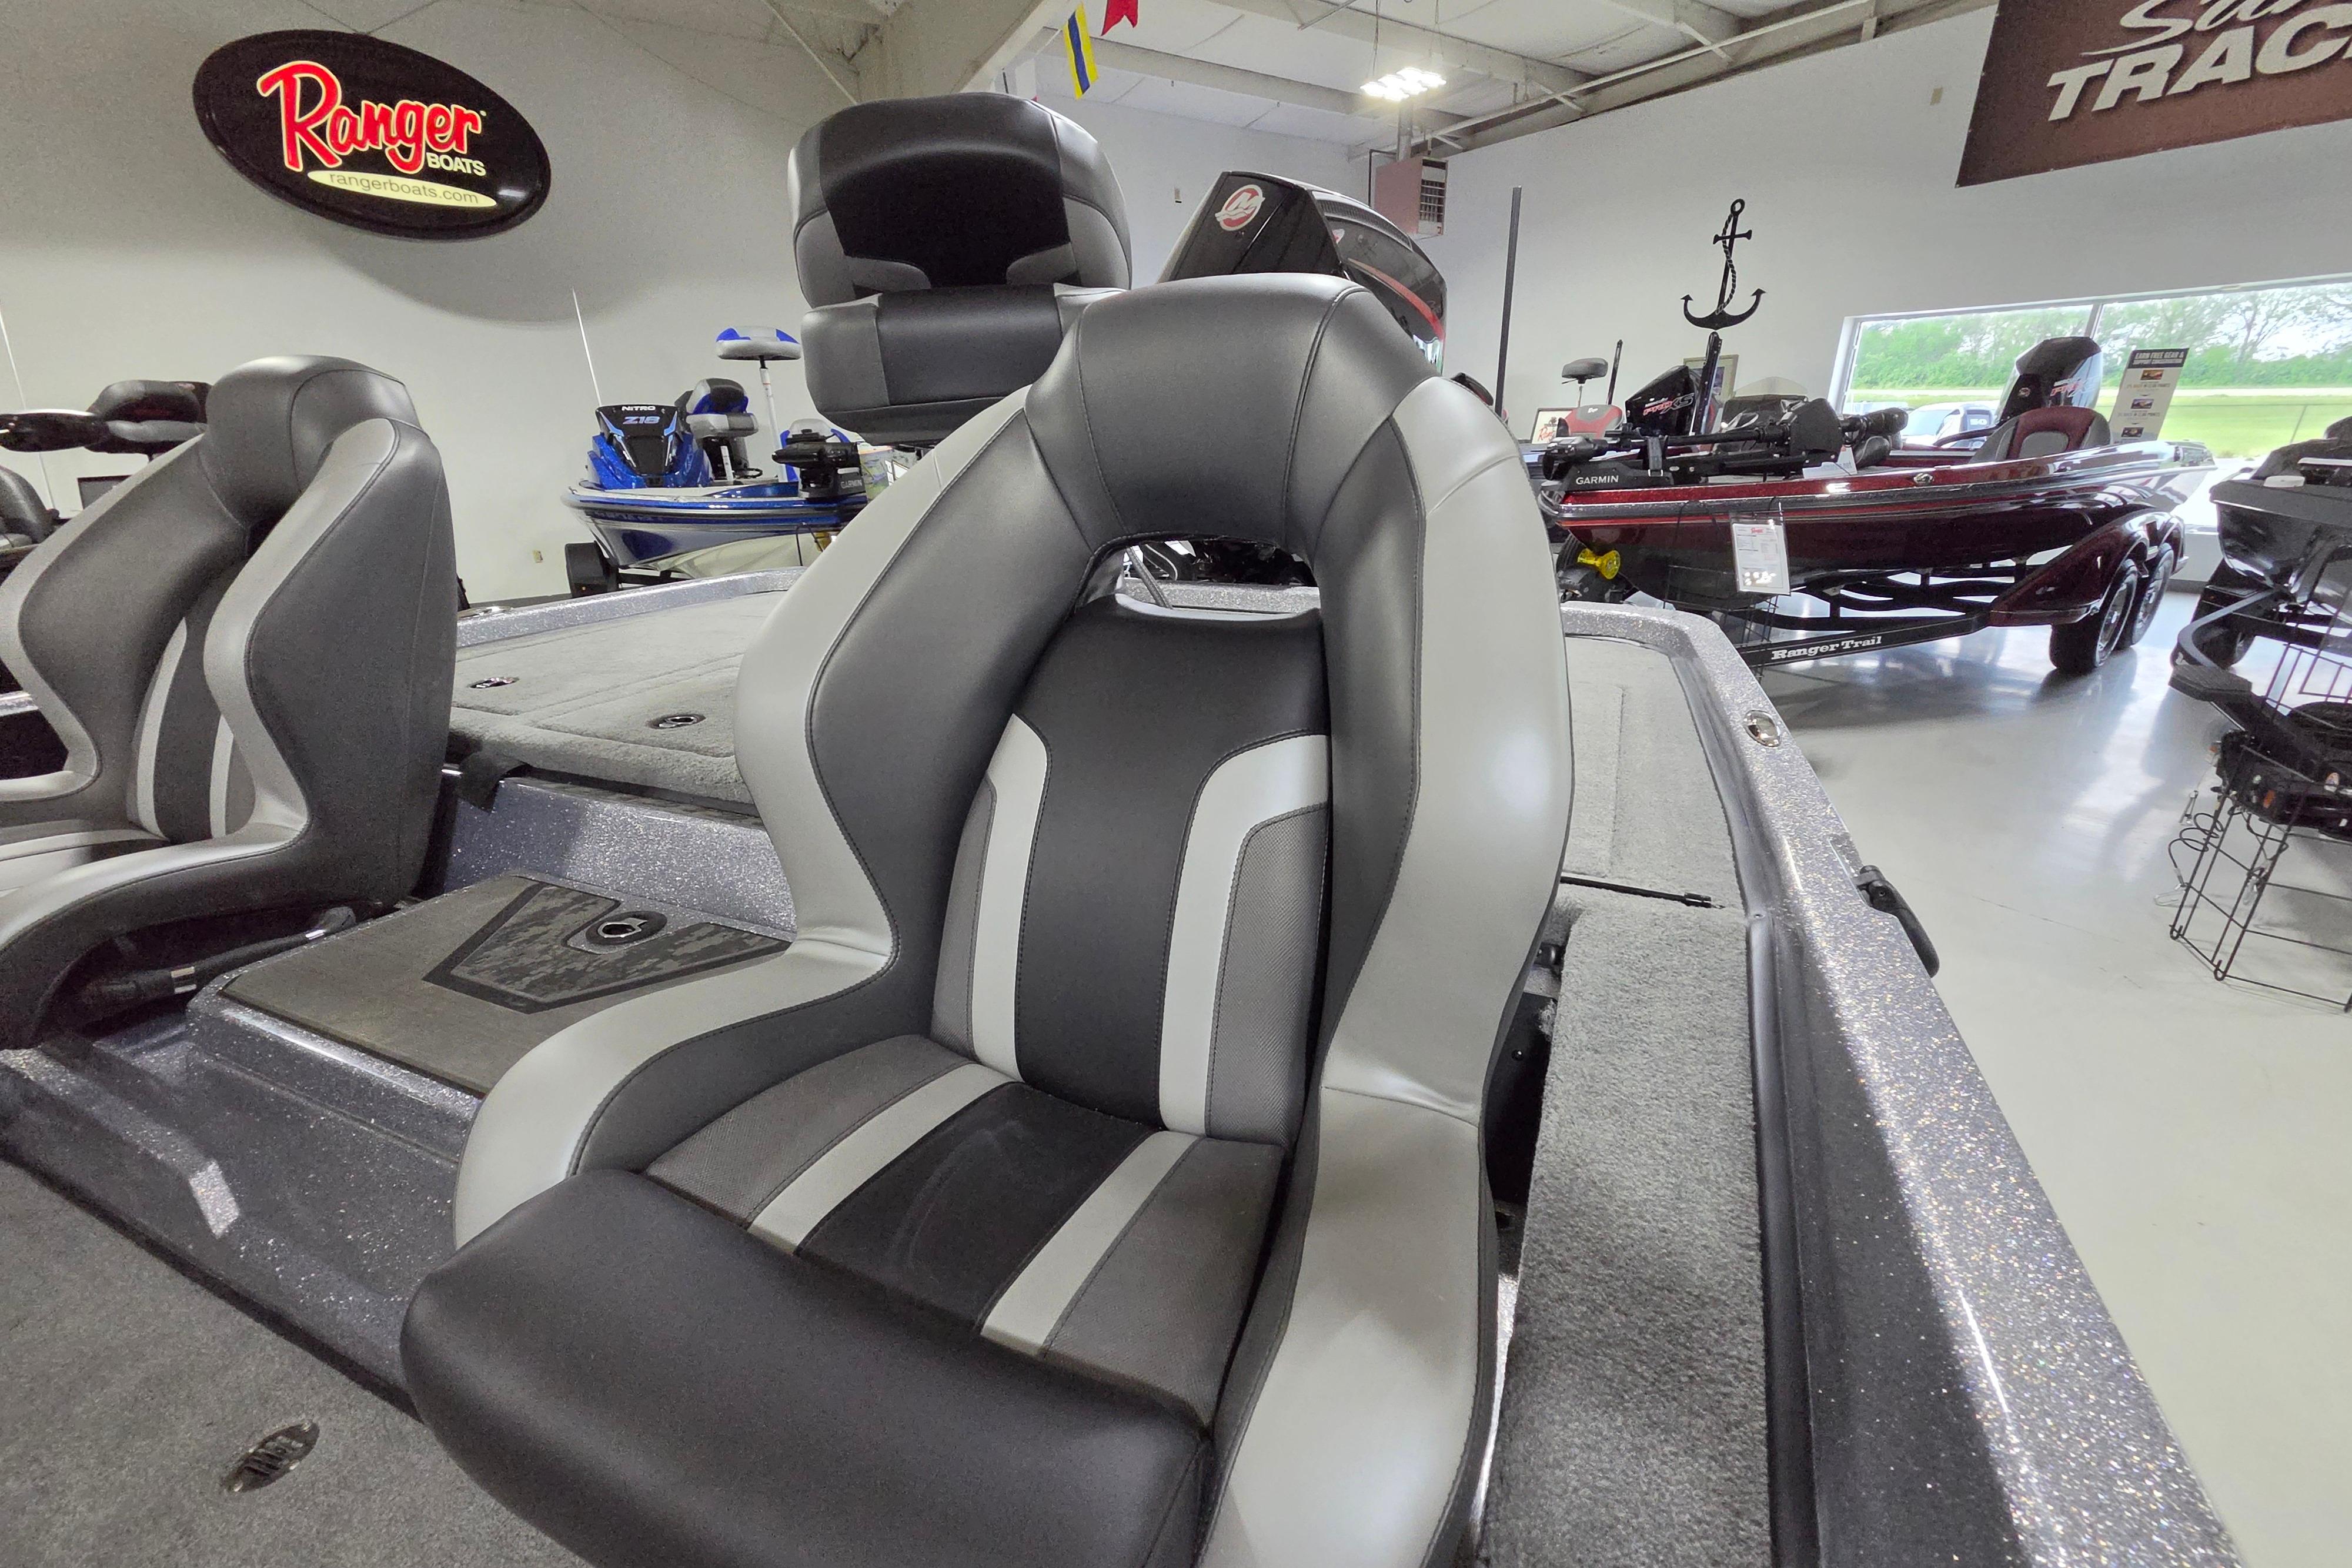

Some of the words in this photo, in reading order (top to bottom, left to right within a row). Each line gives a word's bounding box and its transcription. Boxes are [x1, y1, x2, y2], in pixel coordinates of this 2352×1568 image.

[2046, 3, 2352, 121] TRAC
[257, 61, 482, 174] Ranger
[426, 152, 486, 176] BOATS
[329, 173, 479, 203] rangerboats.com
[1576, 475, 1619, 485] GARMIN
[1771, 643, 1840, 660] Ranger
[1841, 636, 1882, 649] Trail
